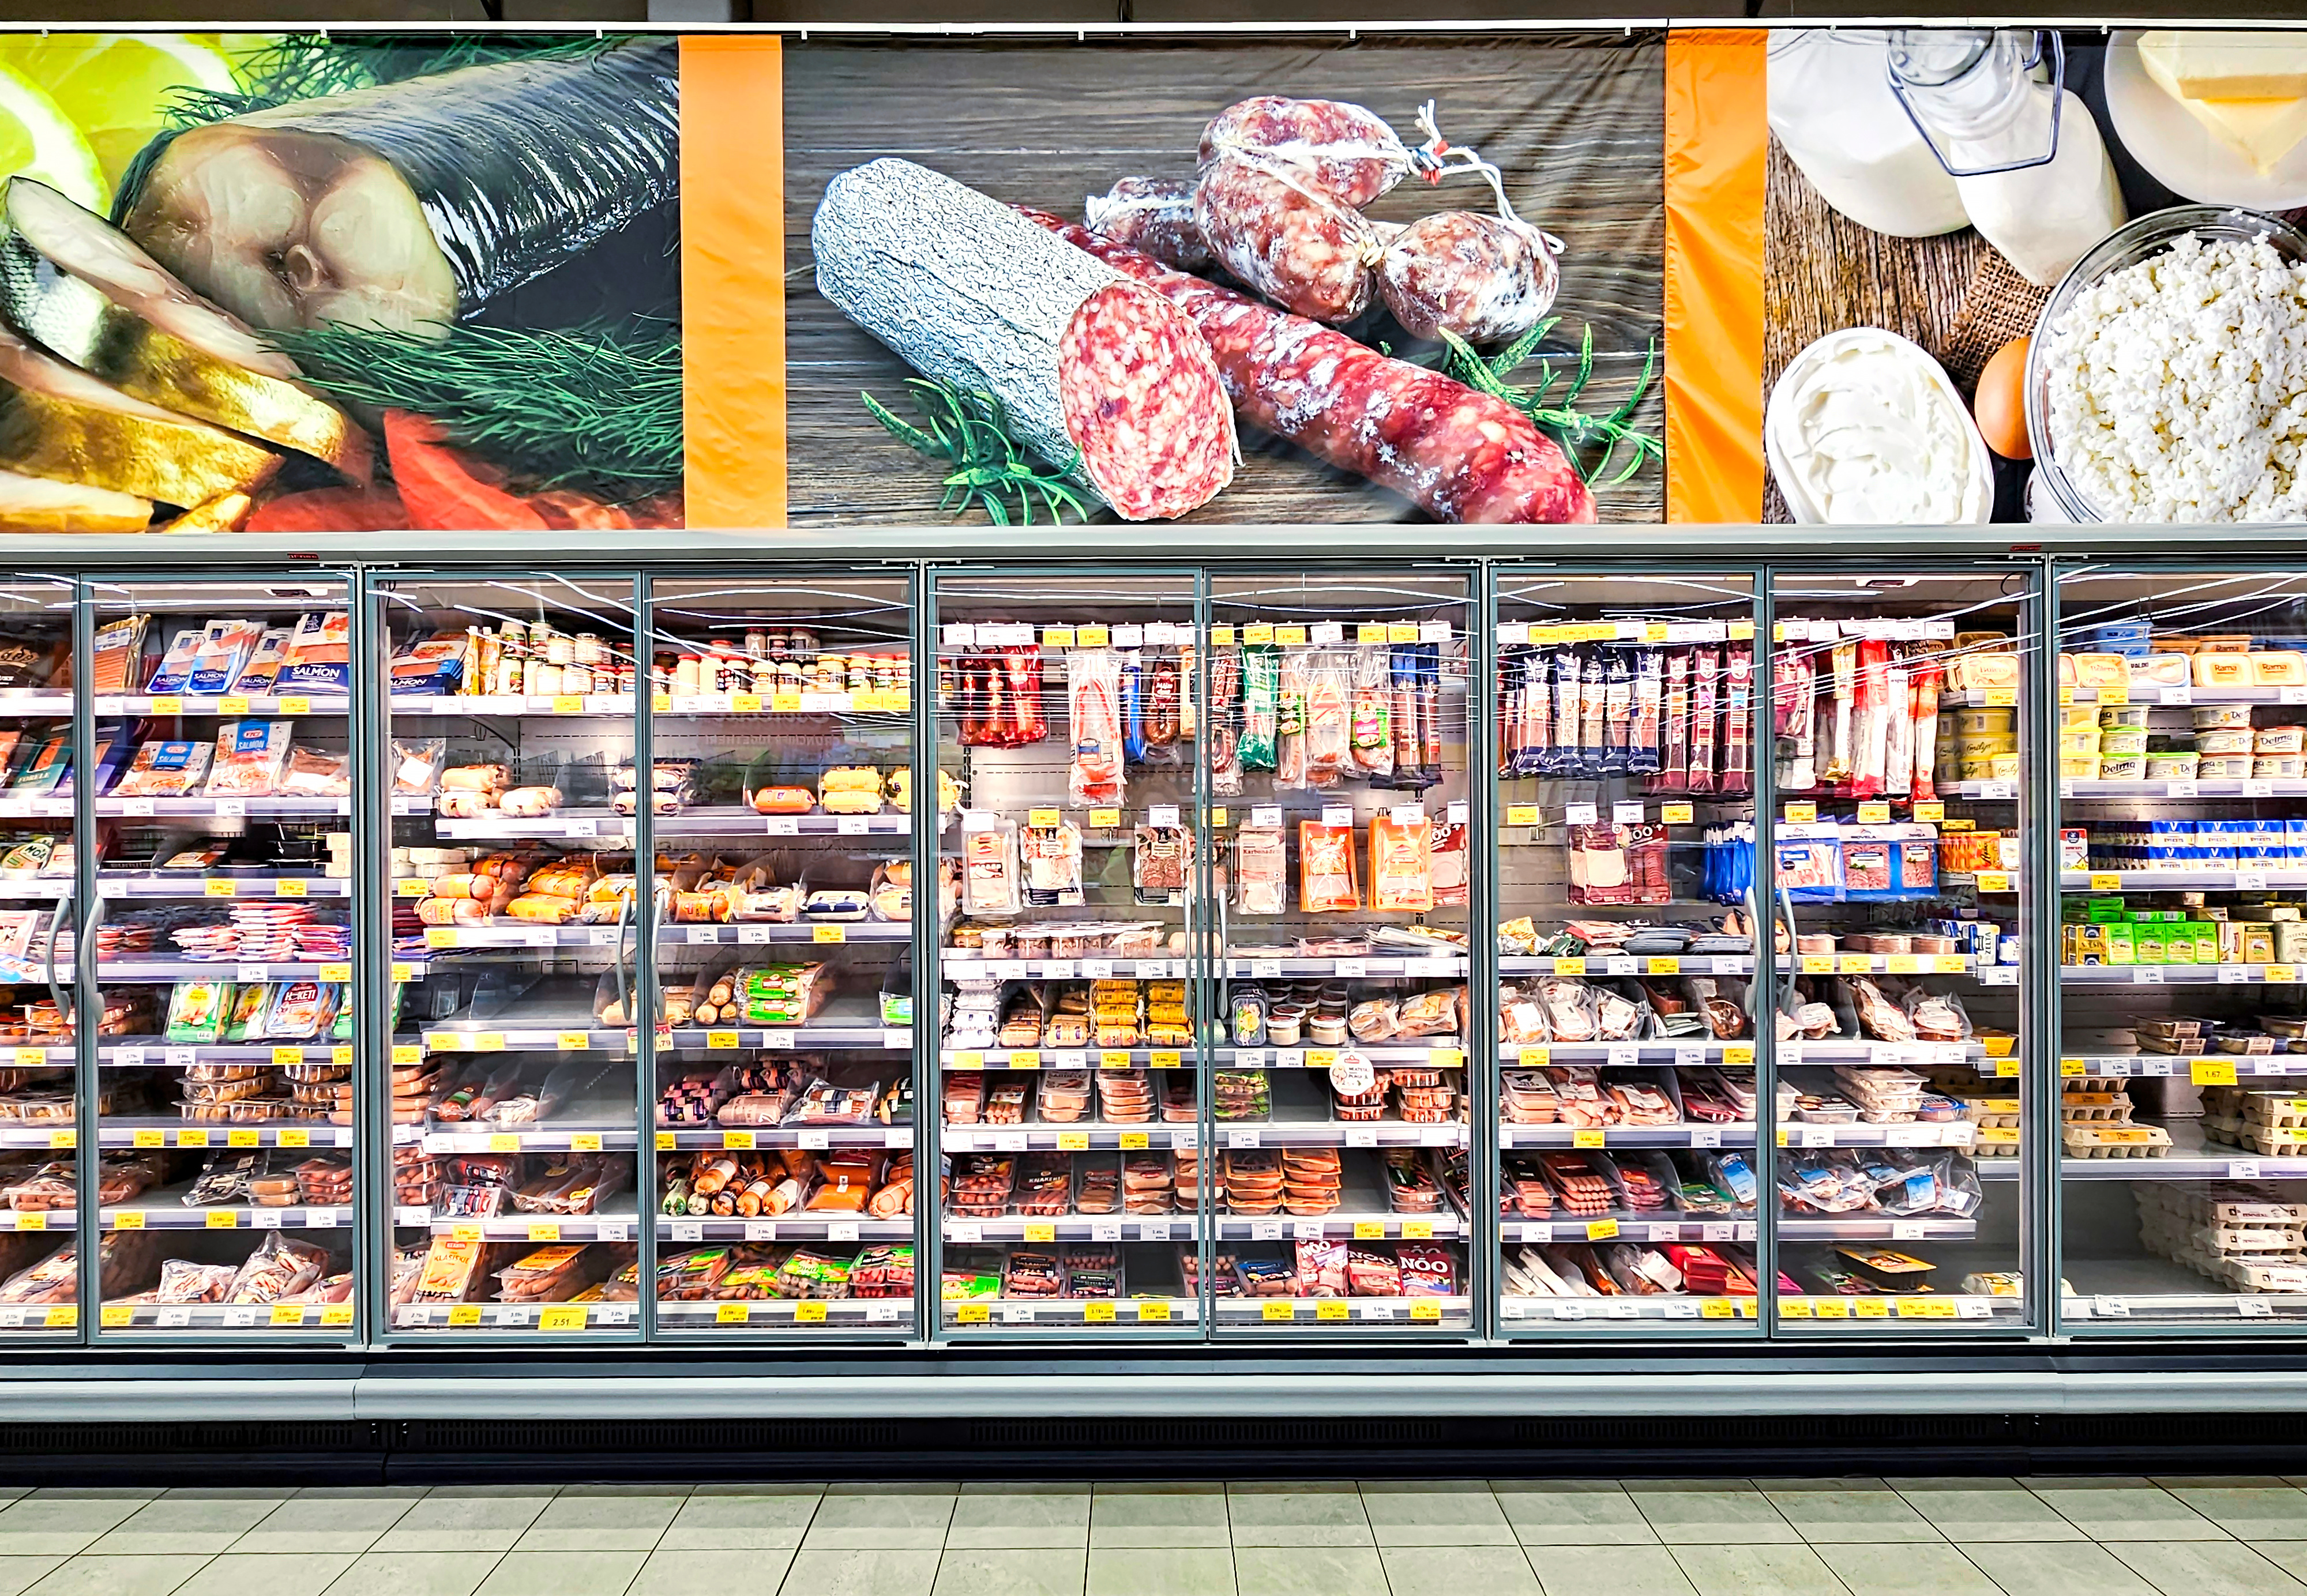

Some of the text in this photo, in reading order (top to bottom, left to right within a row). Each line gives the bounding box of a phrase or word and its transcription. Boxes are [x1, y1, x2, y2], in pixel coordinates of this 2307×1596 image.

[291, 666, 340, 679] SALMON
[2261, 735, 2293, 745] Delma
[2101, 761, 2135, 773] Delma
